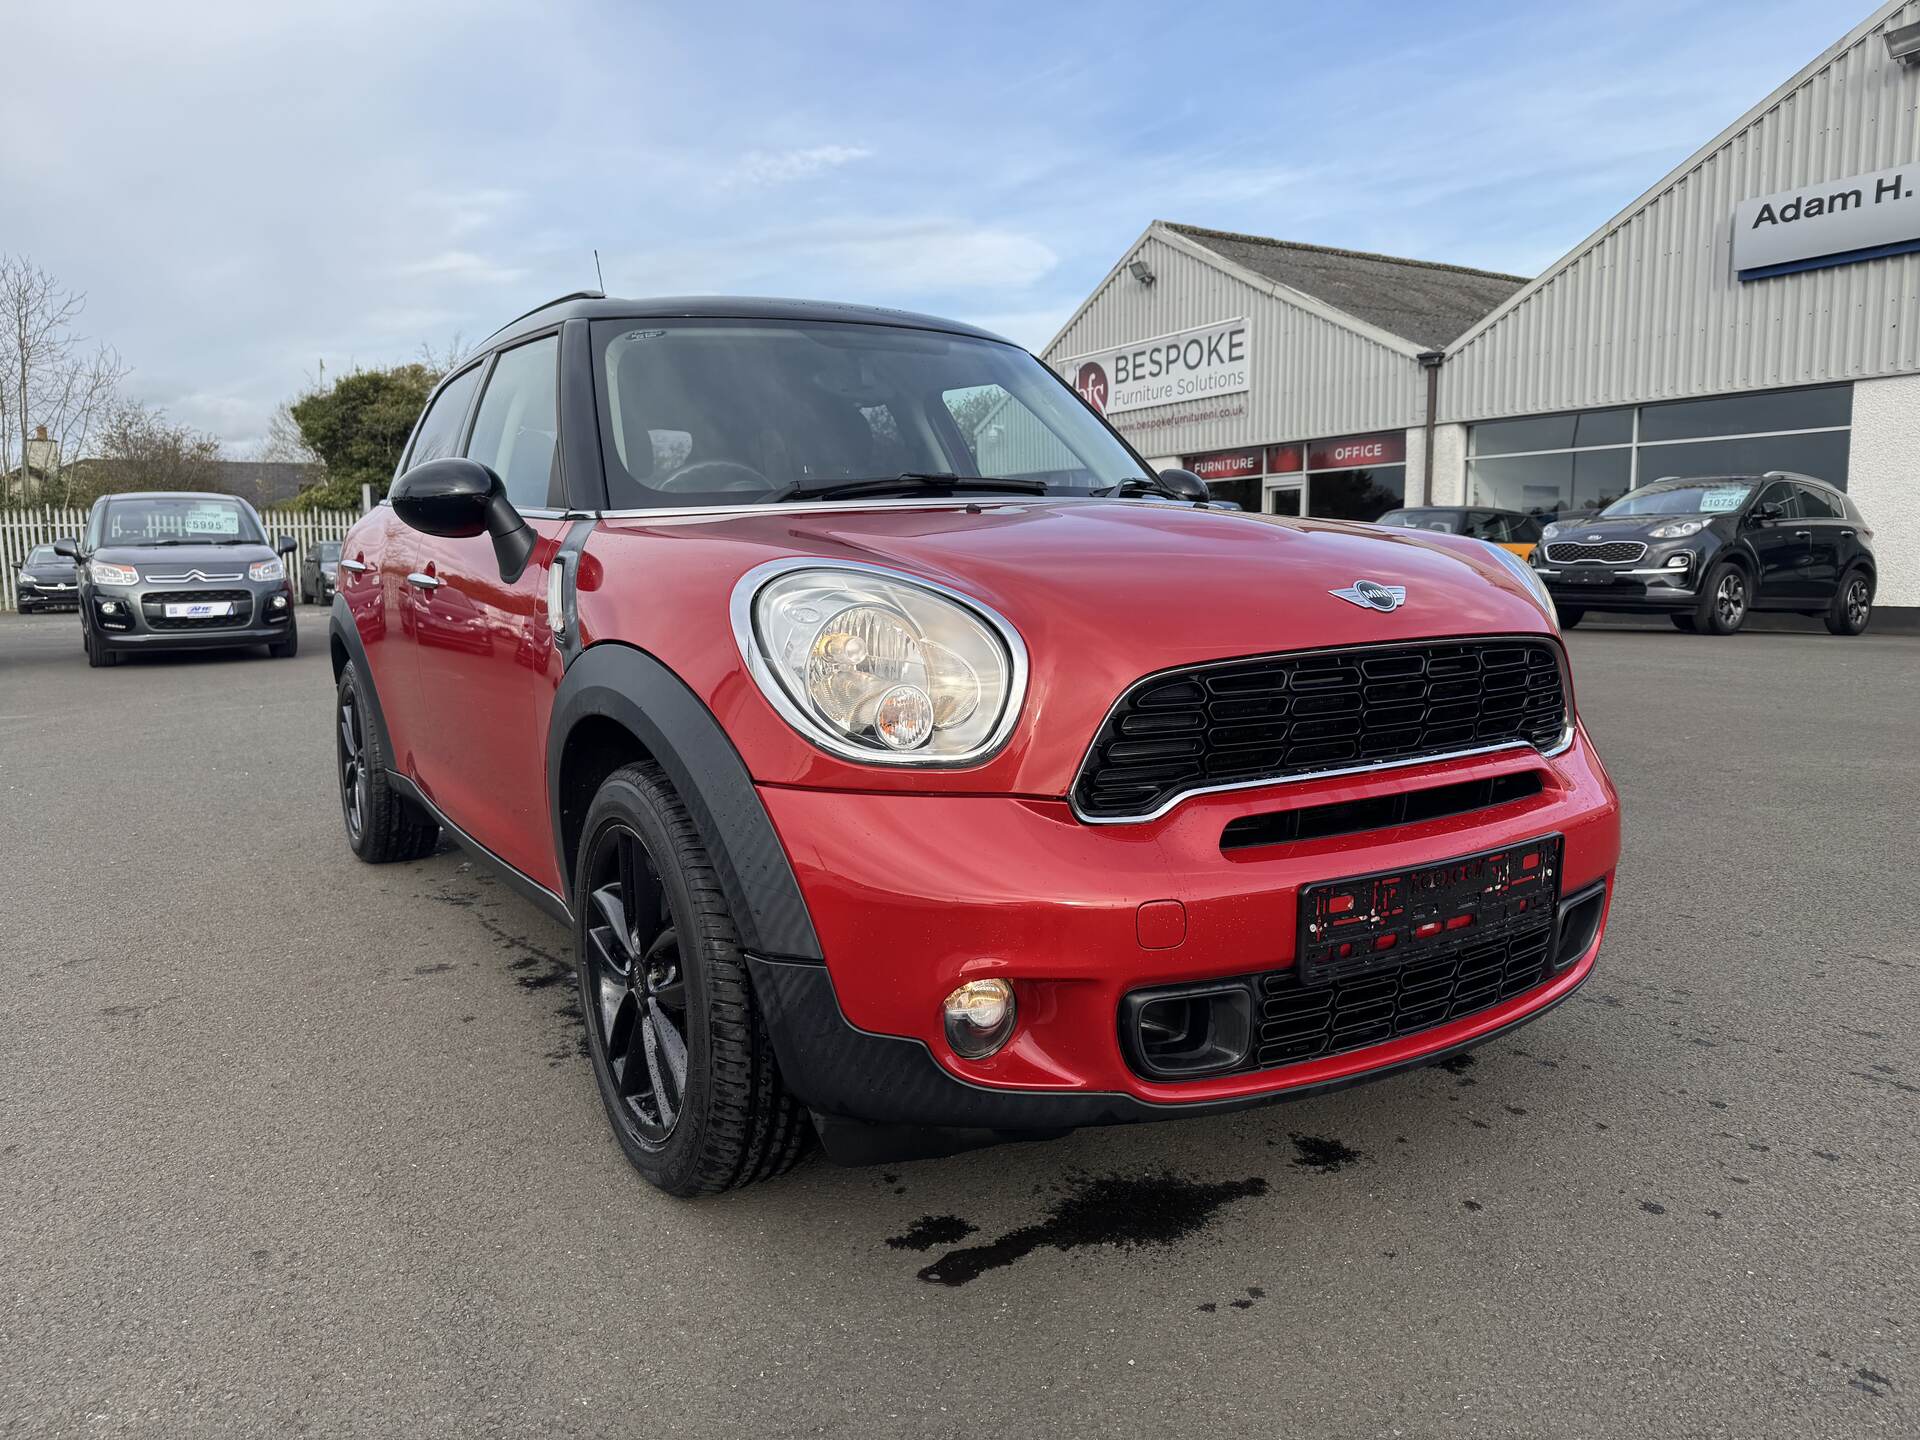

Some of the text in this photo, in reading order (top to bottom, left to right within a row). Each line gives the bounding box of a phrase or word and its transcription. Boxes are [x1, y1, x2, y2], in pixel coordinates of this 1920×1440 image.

[1752, 174, 1913, 229] Adam H.
[1115, 328, 1245, 385] BESPOKE
[1114, 371, 1245, 406] Furniture Solutions
[1335, 443, 1382, 460] OFFICE
[1194, 457, 1254, 474] FURNITURE
[1361, 589, 1392, 599] MINI
